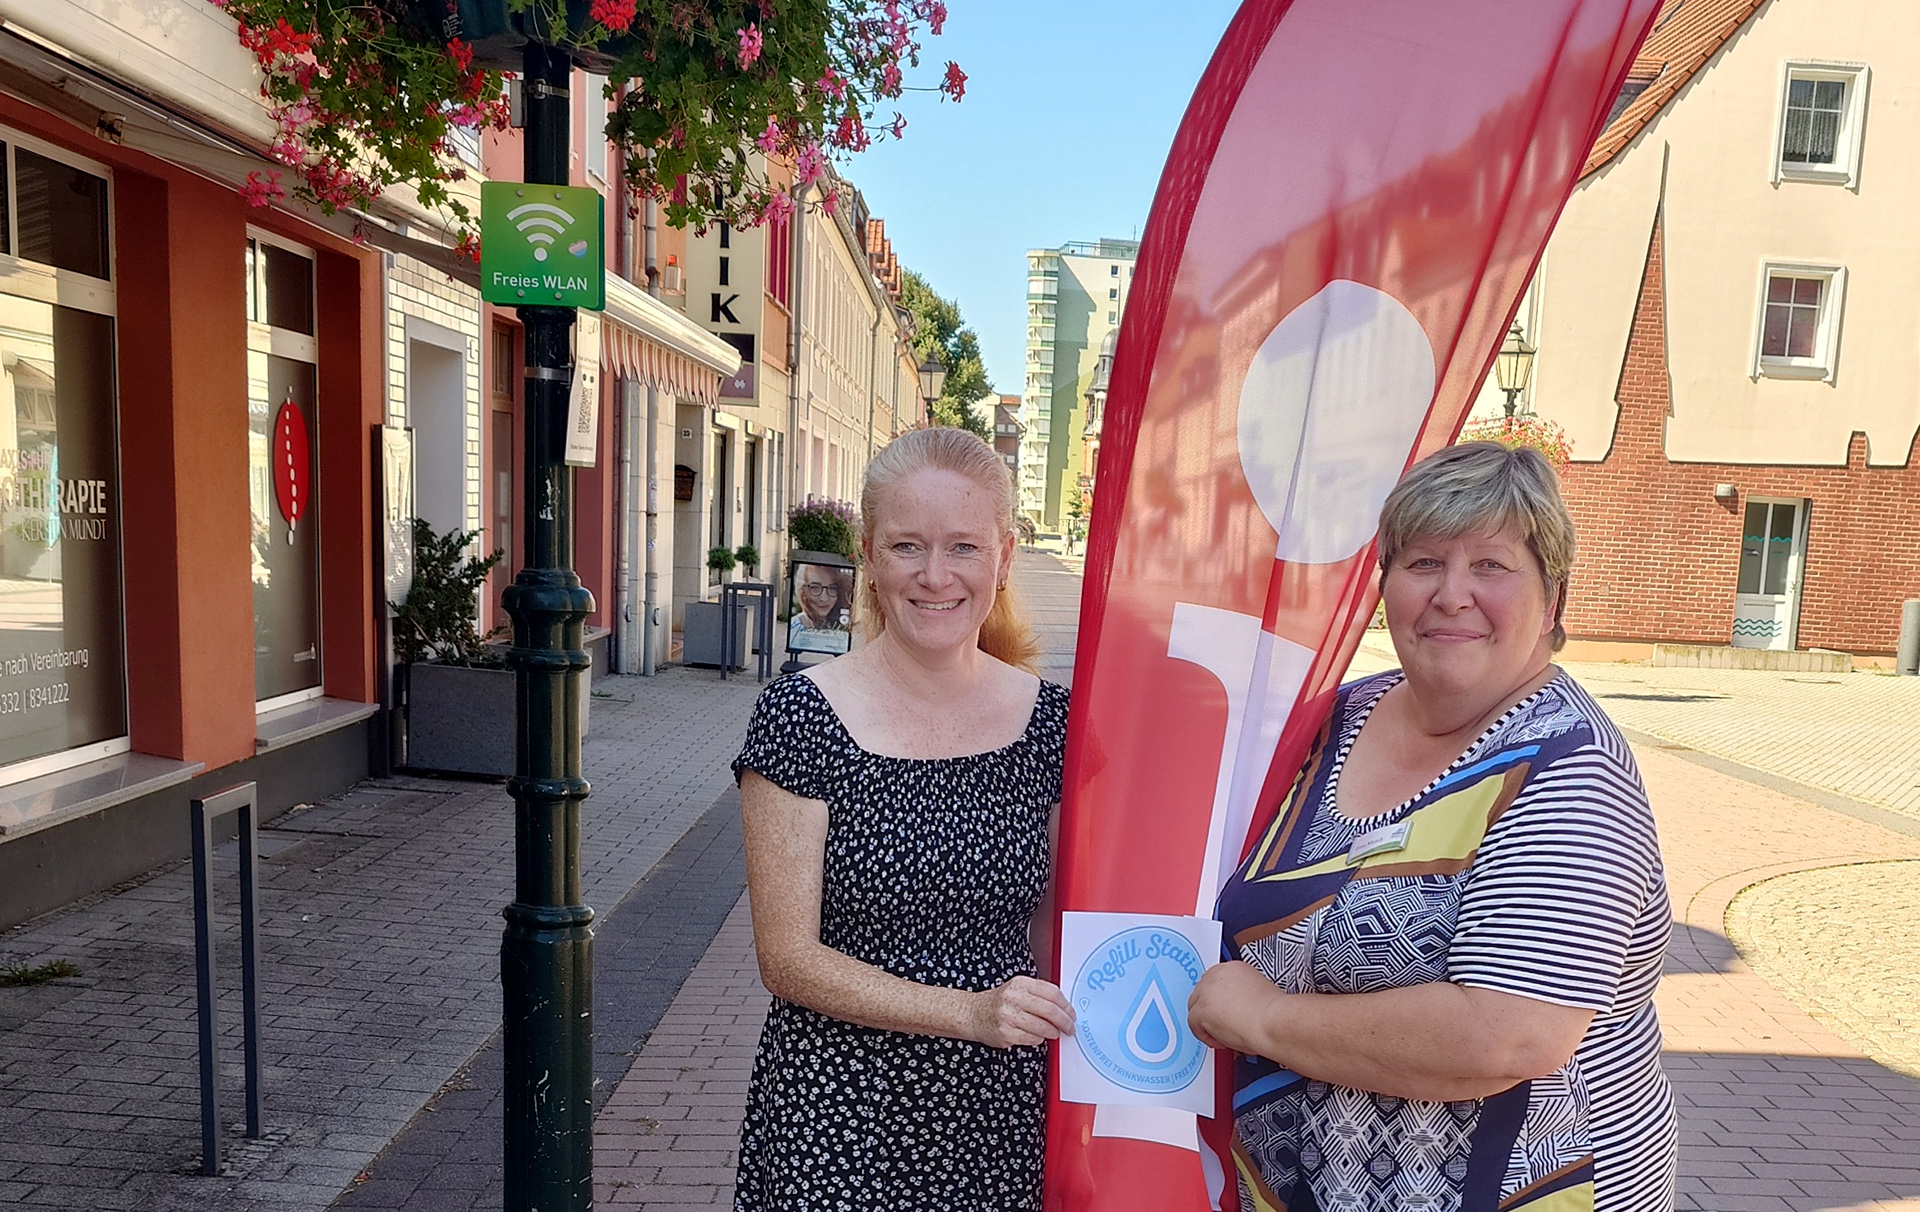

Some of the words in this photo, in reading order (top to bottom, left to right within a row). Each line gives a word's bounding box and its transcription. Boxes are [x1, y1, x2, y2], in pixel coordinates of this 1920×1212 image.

[493, 272, 539, 288] Freies
[543, 275, 588, 291] WLAN
[69, 518, 107, 541] MUNDT
[5, 653, 28, 676] nach
[30, 648, 89, 669] Vereinbarung
[0, 691, 20, 714] 332
[29, 682, 70, 709] 8341222
[1087, 938, 1142, 991] Refill
[1145, 933, 1199, 987] Statio
[1080, 1020, 1113, 1068] KOSTENFREI
[1111, 1063, 1171, 1085] TRINKWASSER
[1174, 1066, 1190, 1081] FREE
